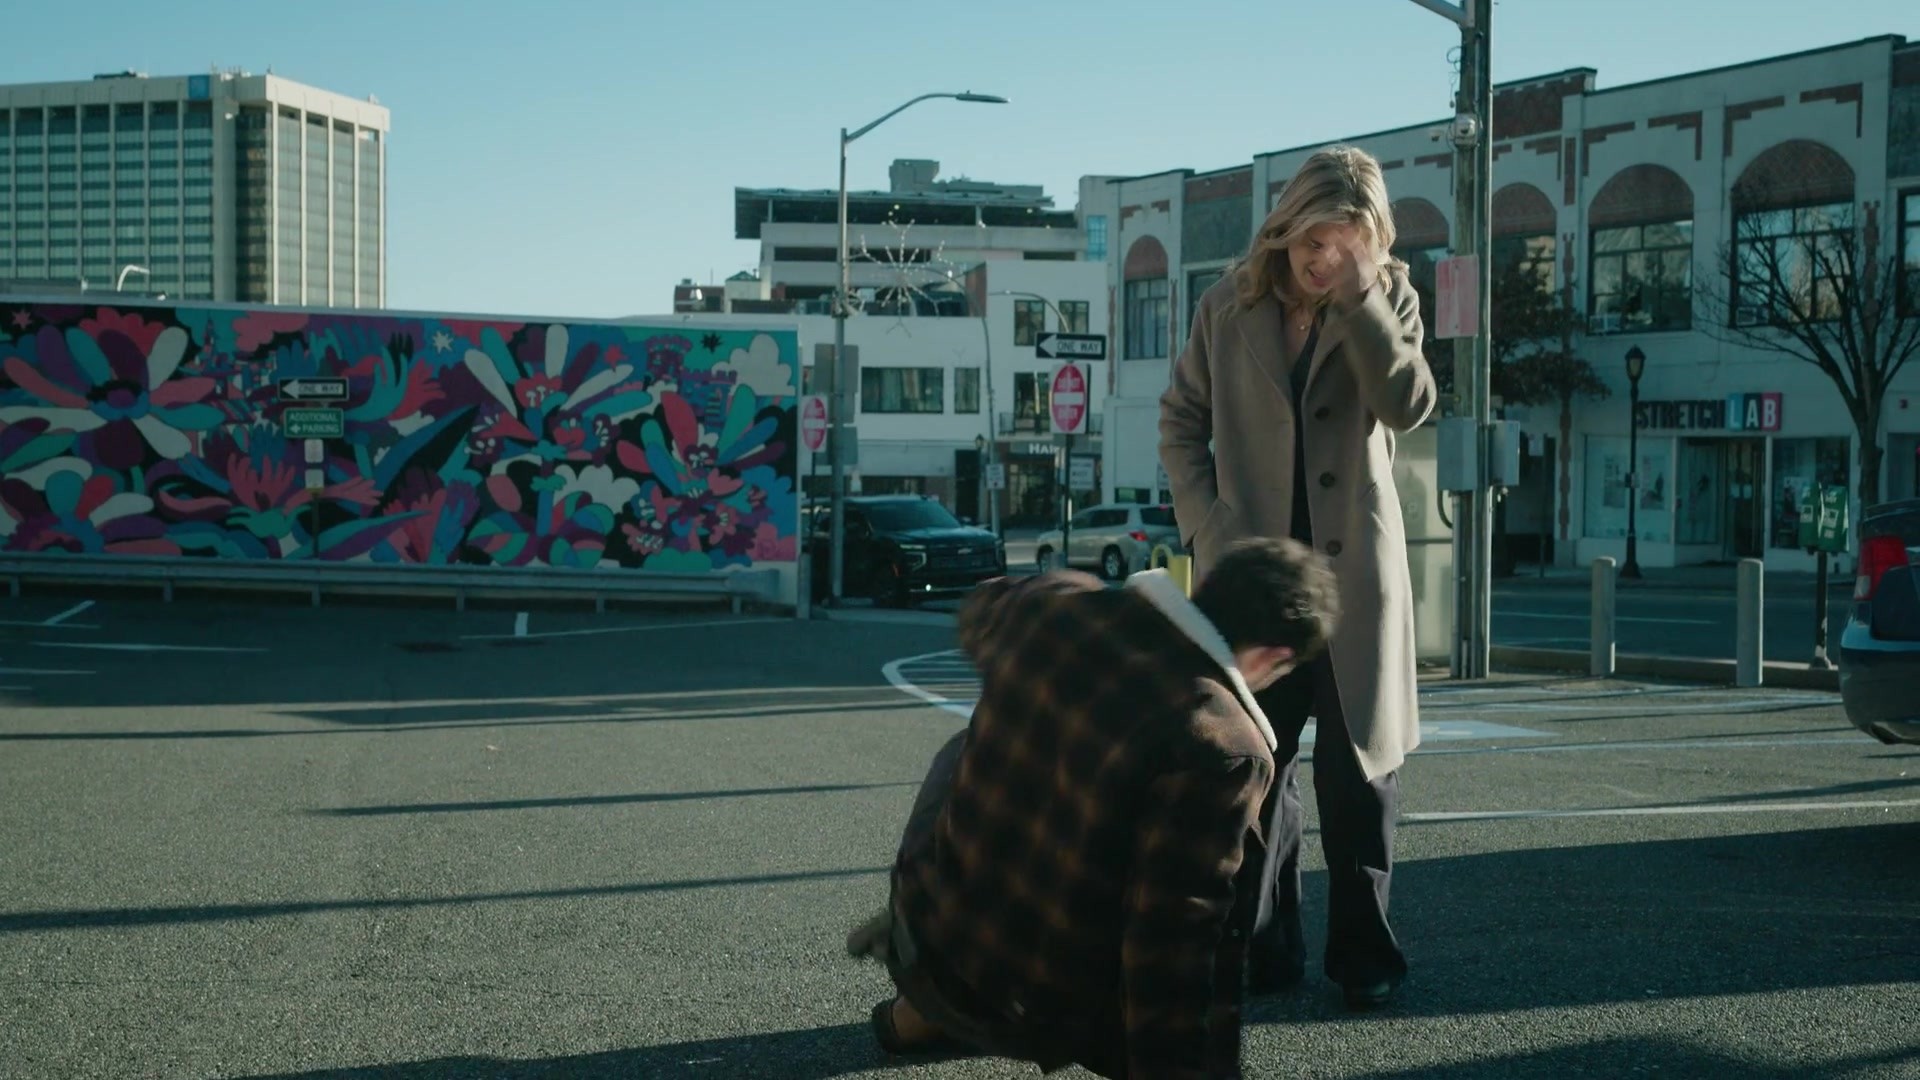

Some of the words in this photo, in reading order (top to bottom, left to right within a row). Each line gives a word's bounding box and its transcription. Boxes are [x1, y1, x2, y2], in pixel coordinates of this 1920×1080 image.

[1057, 342, 1075, 352] ONE
[1081, 342, 1099, 352] WAY
[299, 382, 316, 393] ONE
[321, 383, 340, 393] WAY
[289, 412, 338, 422] ADDITIONAL
[302, 423, 339, 433] PARKING
